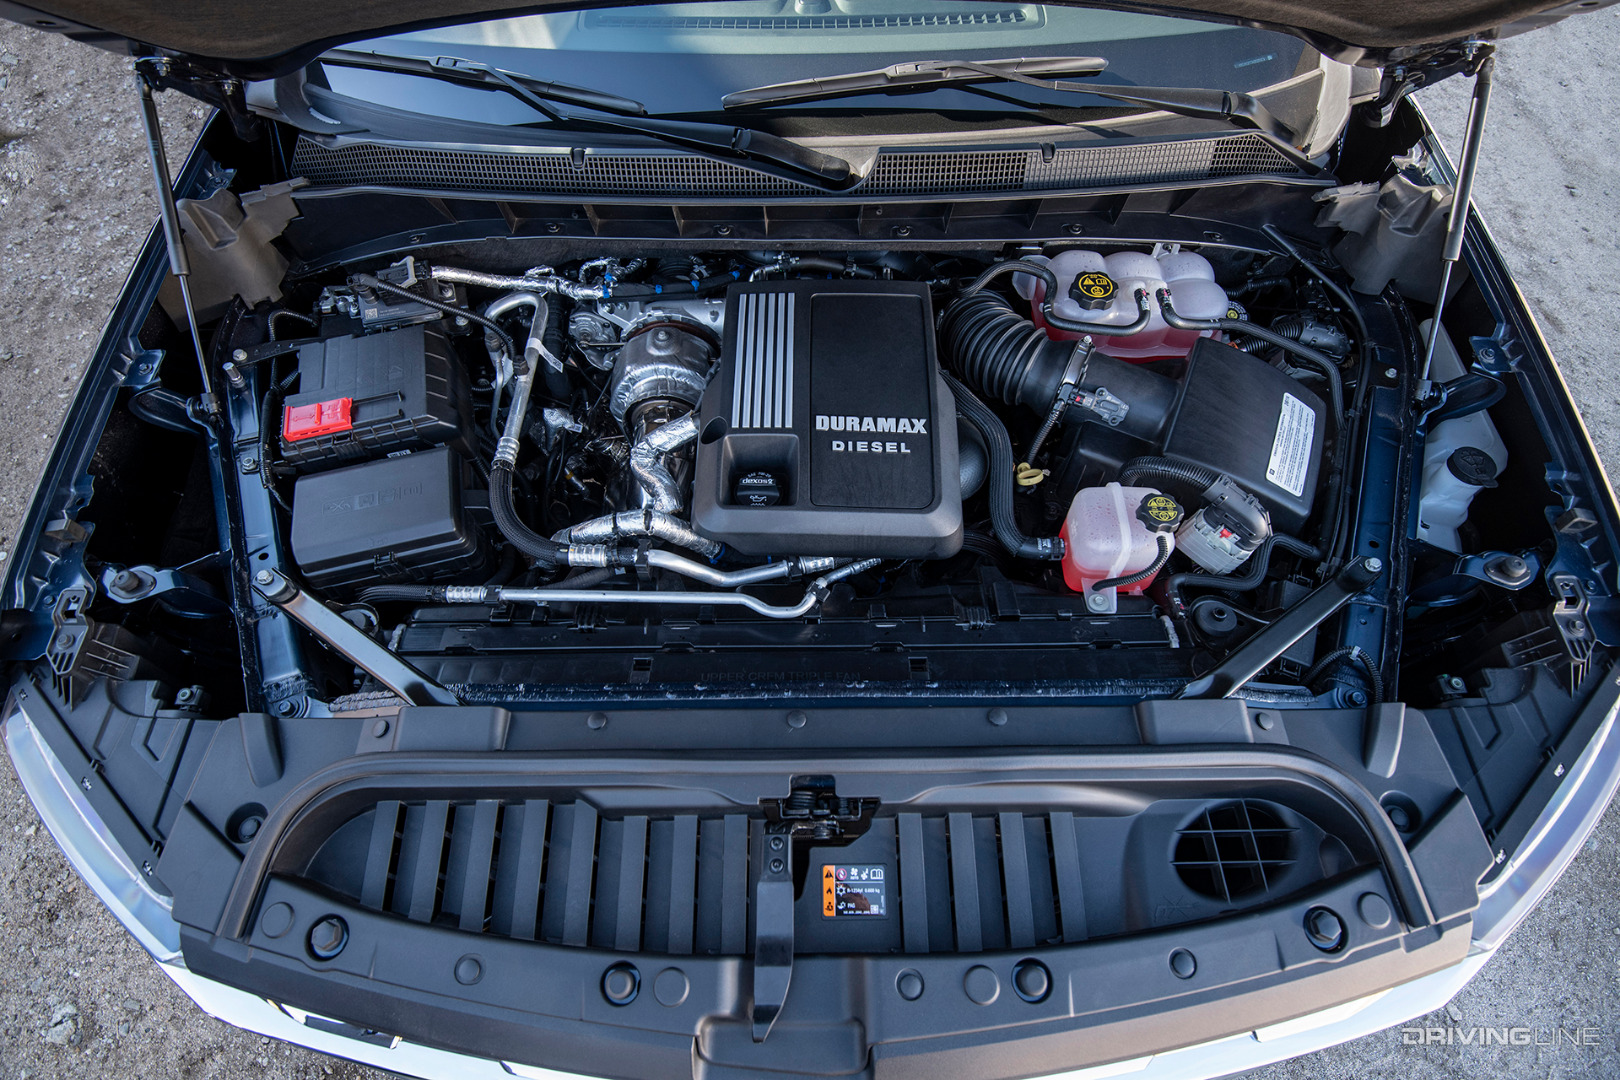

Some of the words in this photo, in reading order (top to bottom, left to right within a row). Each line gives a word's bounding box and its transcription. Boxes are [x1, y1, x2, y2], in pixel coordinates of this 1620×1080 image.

[815, 415, 928, 434] DURAMAX
[831, 440, 912, 454] DIESEL
[700, 671, 745, 682] UPPER
[787, 671, 833, 681] TRIPLE
[835, 671, 861, 681] FAN
